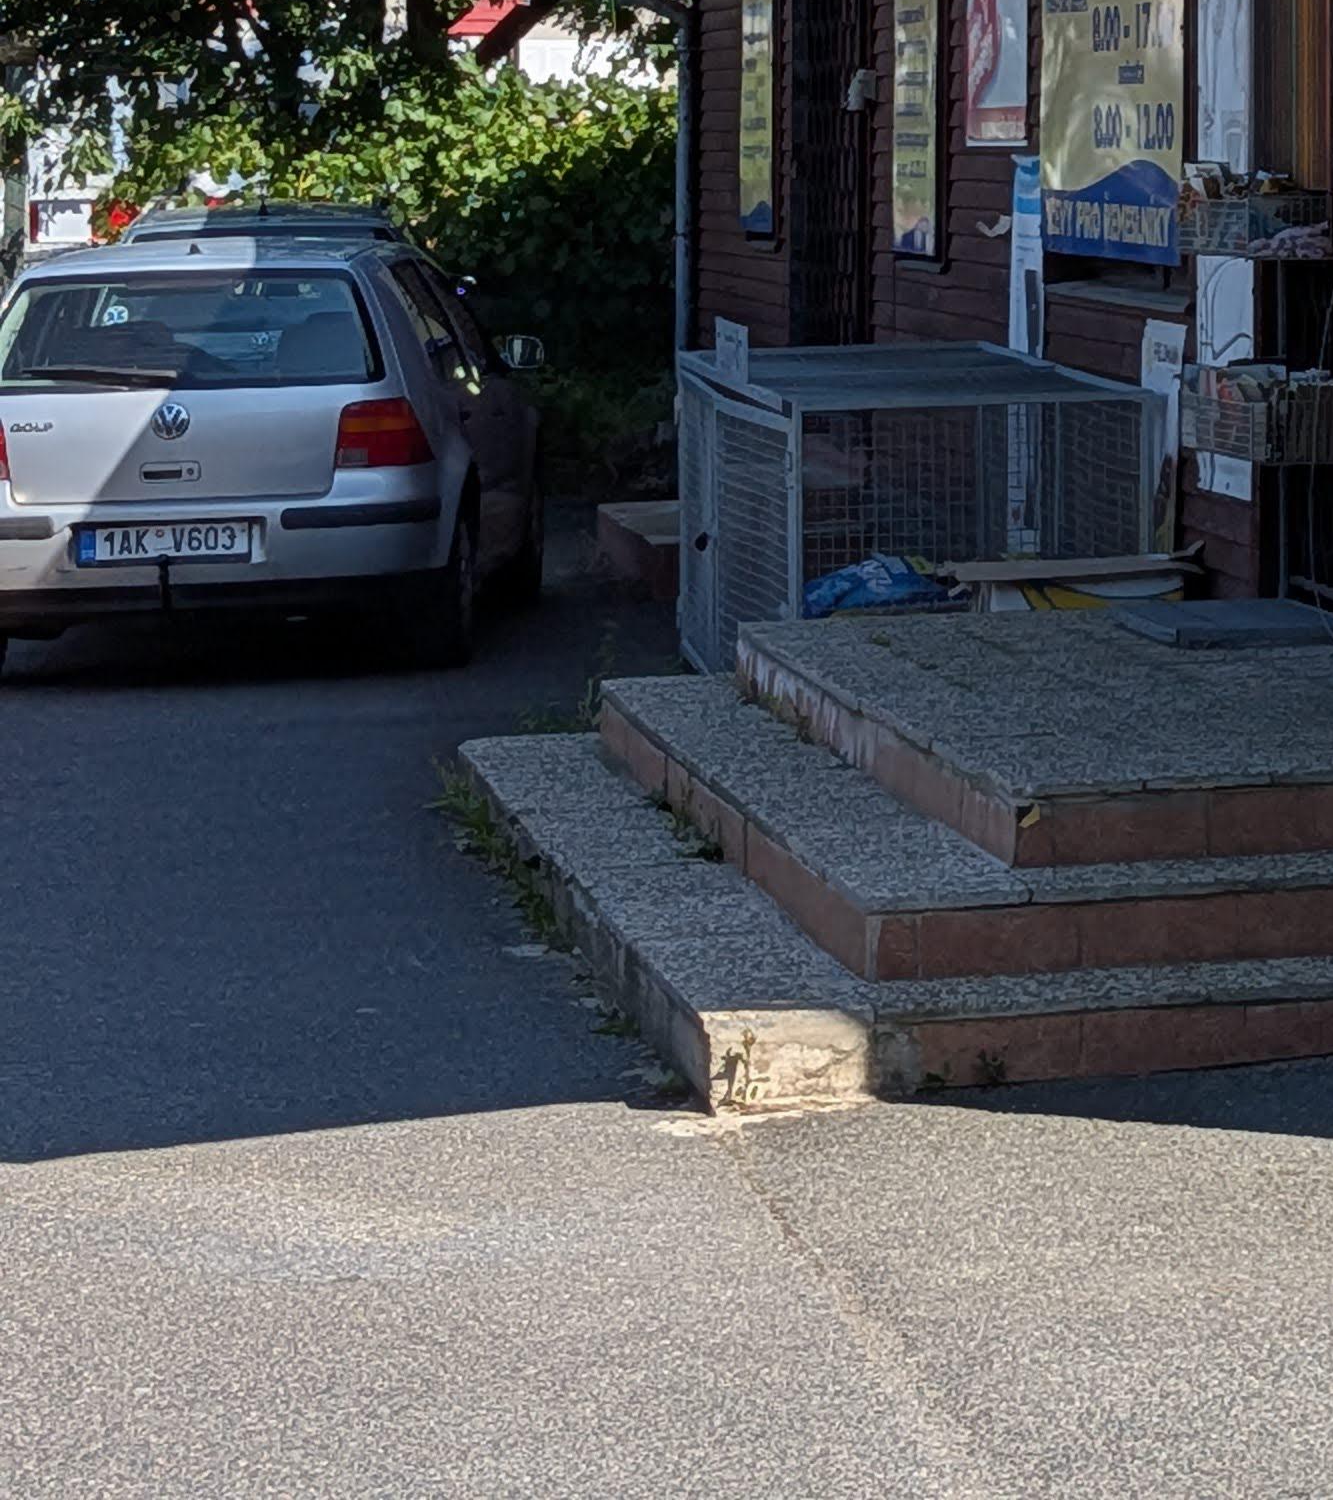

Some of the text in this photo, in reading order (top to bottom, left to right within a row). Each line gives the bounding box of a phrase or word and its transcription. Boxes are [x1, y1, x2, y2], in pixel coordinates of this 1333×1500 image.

[1135, 1, 1175, 51] 17.
[1136, 102, 1175, 151] 12.00
[103, 525, 237, 557] 1AK V603
